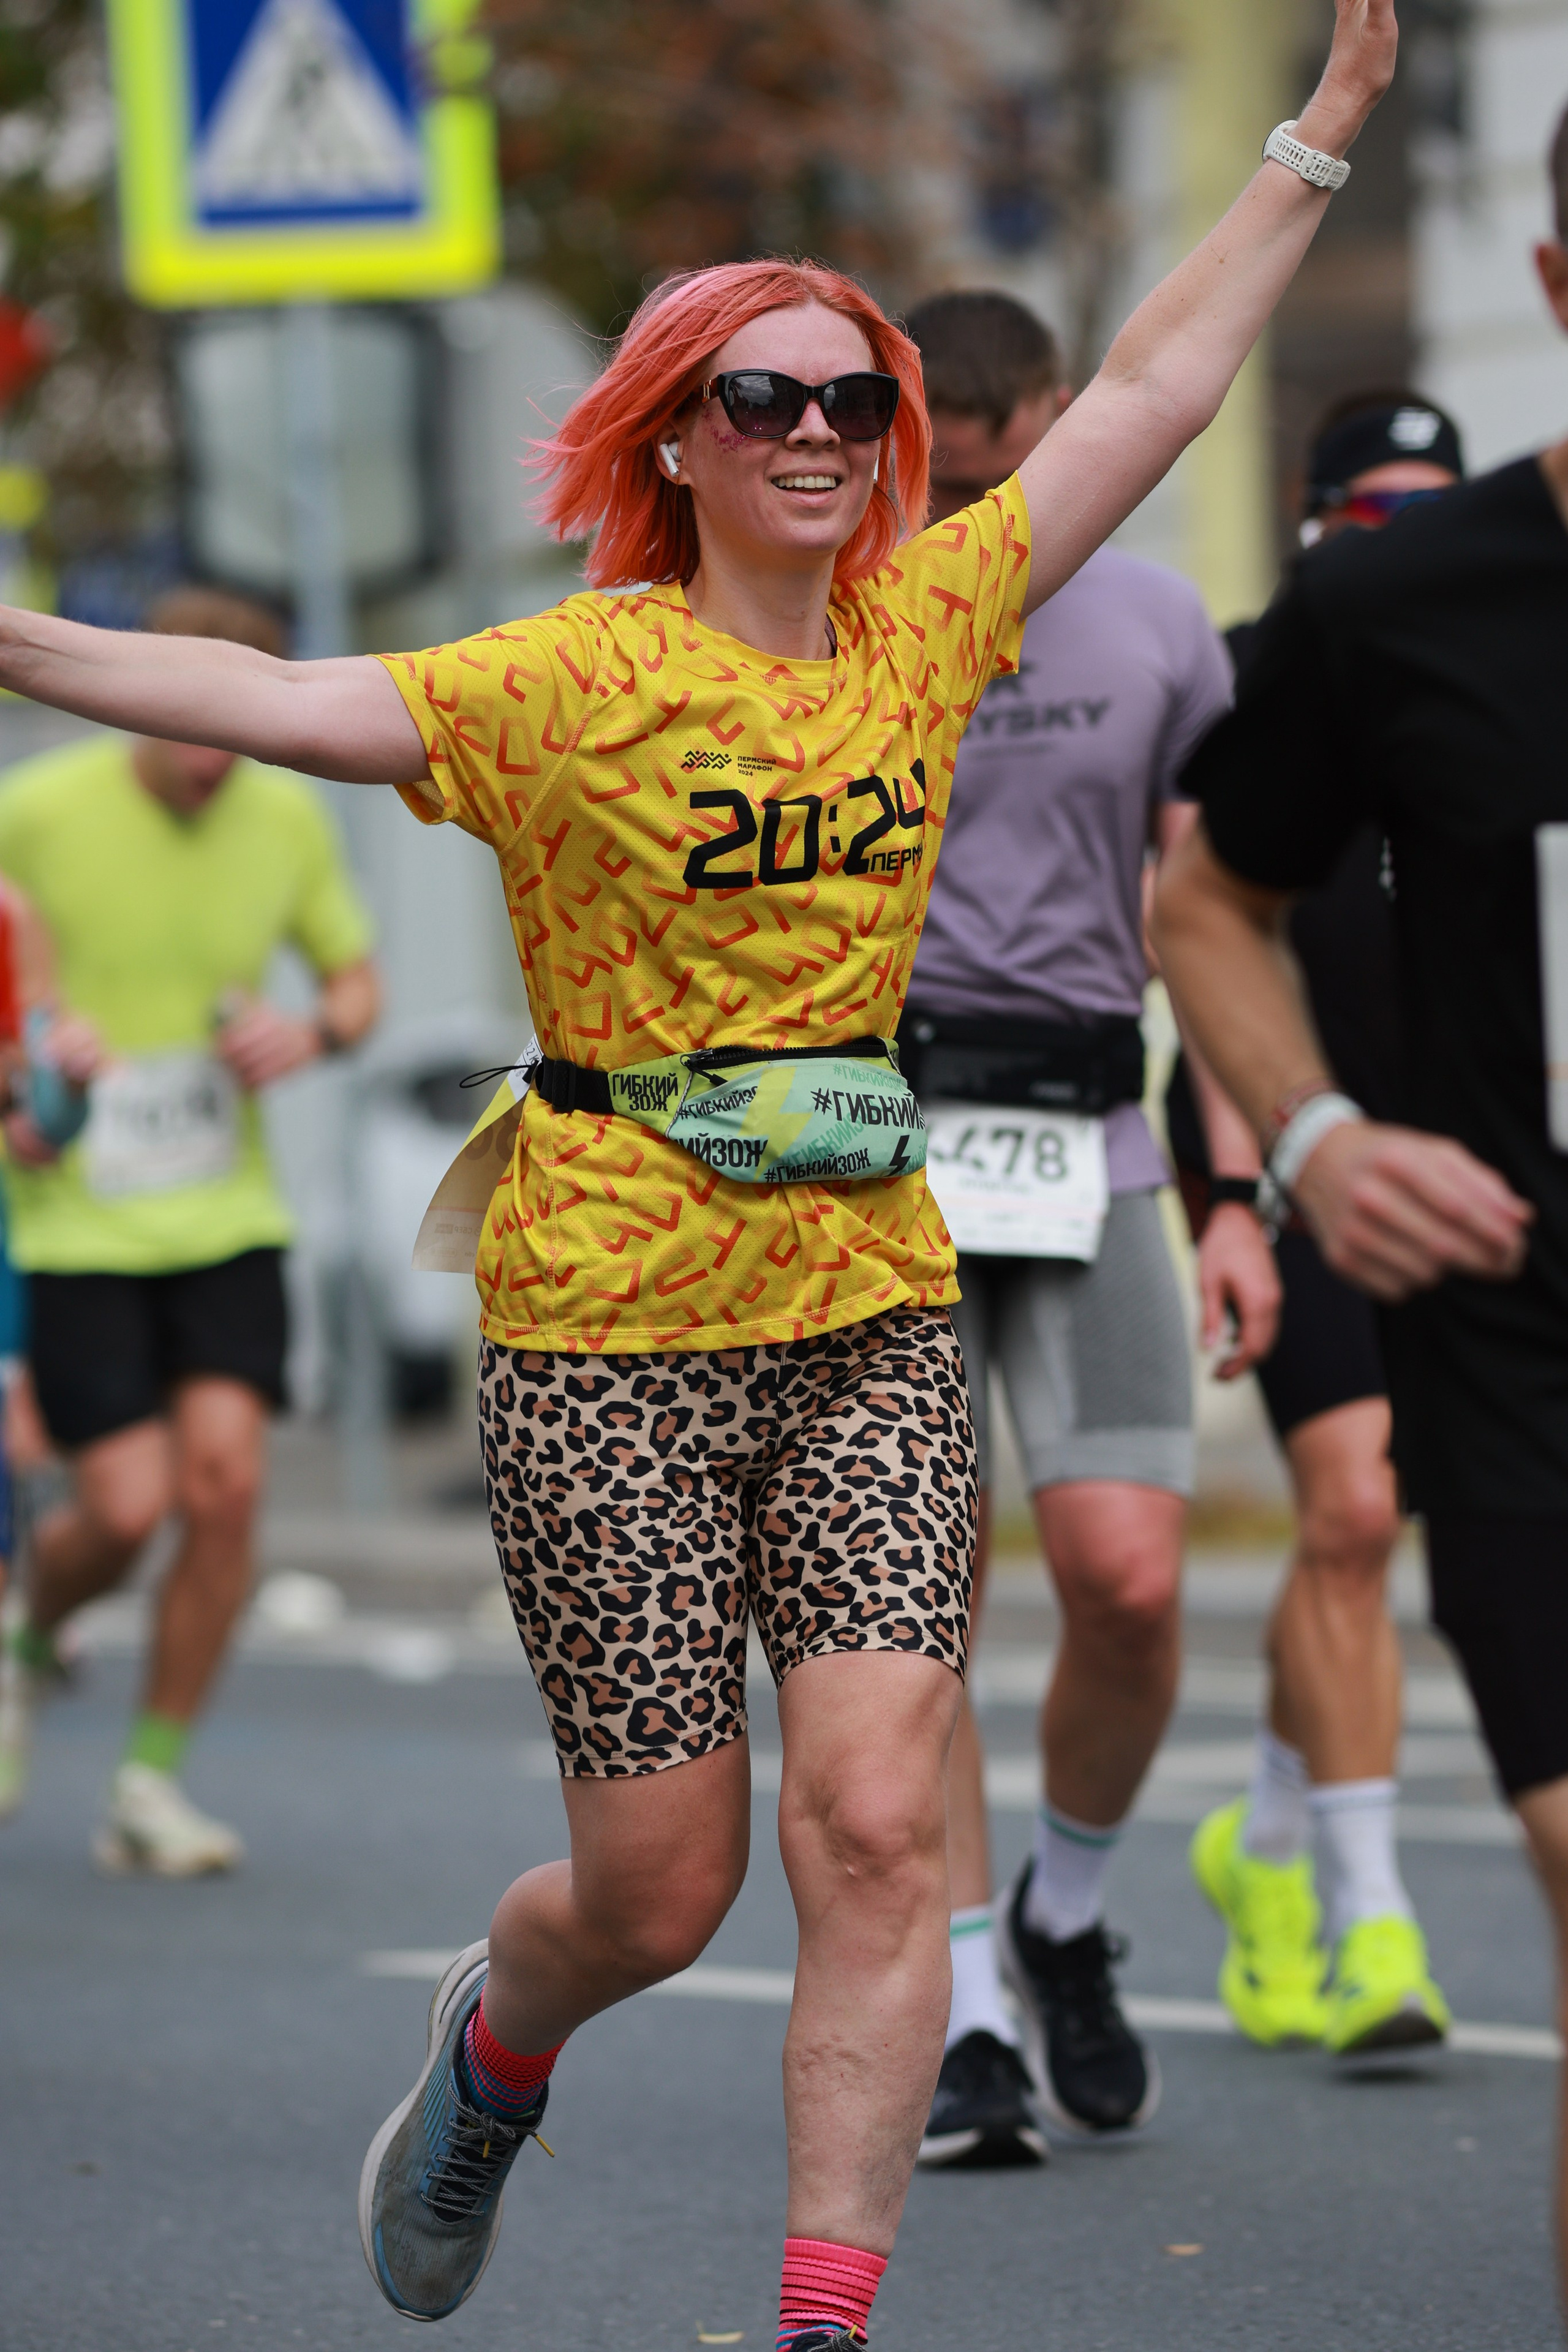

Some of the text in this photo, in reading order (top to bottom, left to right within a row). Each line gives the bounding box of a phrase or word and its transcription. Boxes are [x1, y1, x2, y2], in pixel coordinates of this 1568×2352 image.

[737, 755, 777, 766] ПЕРМСКИЙ
[737, 763, 772, 772] МАРАФОН
[682, 758, 925, 889] 20:24
[613, 1072, 679, 1096] ГИБКИЙ
[628, 1093, 668, 1112] ЗОЖ
[764, 1148, 871, 1183] #ГИБКИЙЗОЖ
